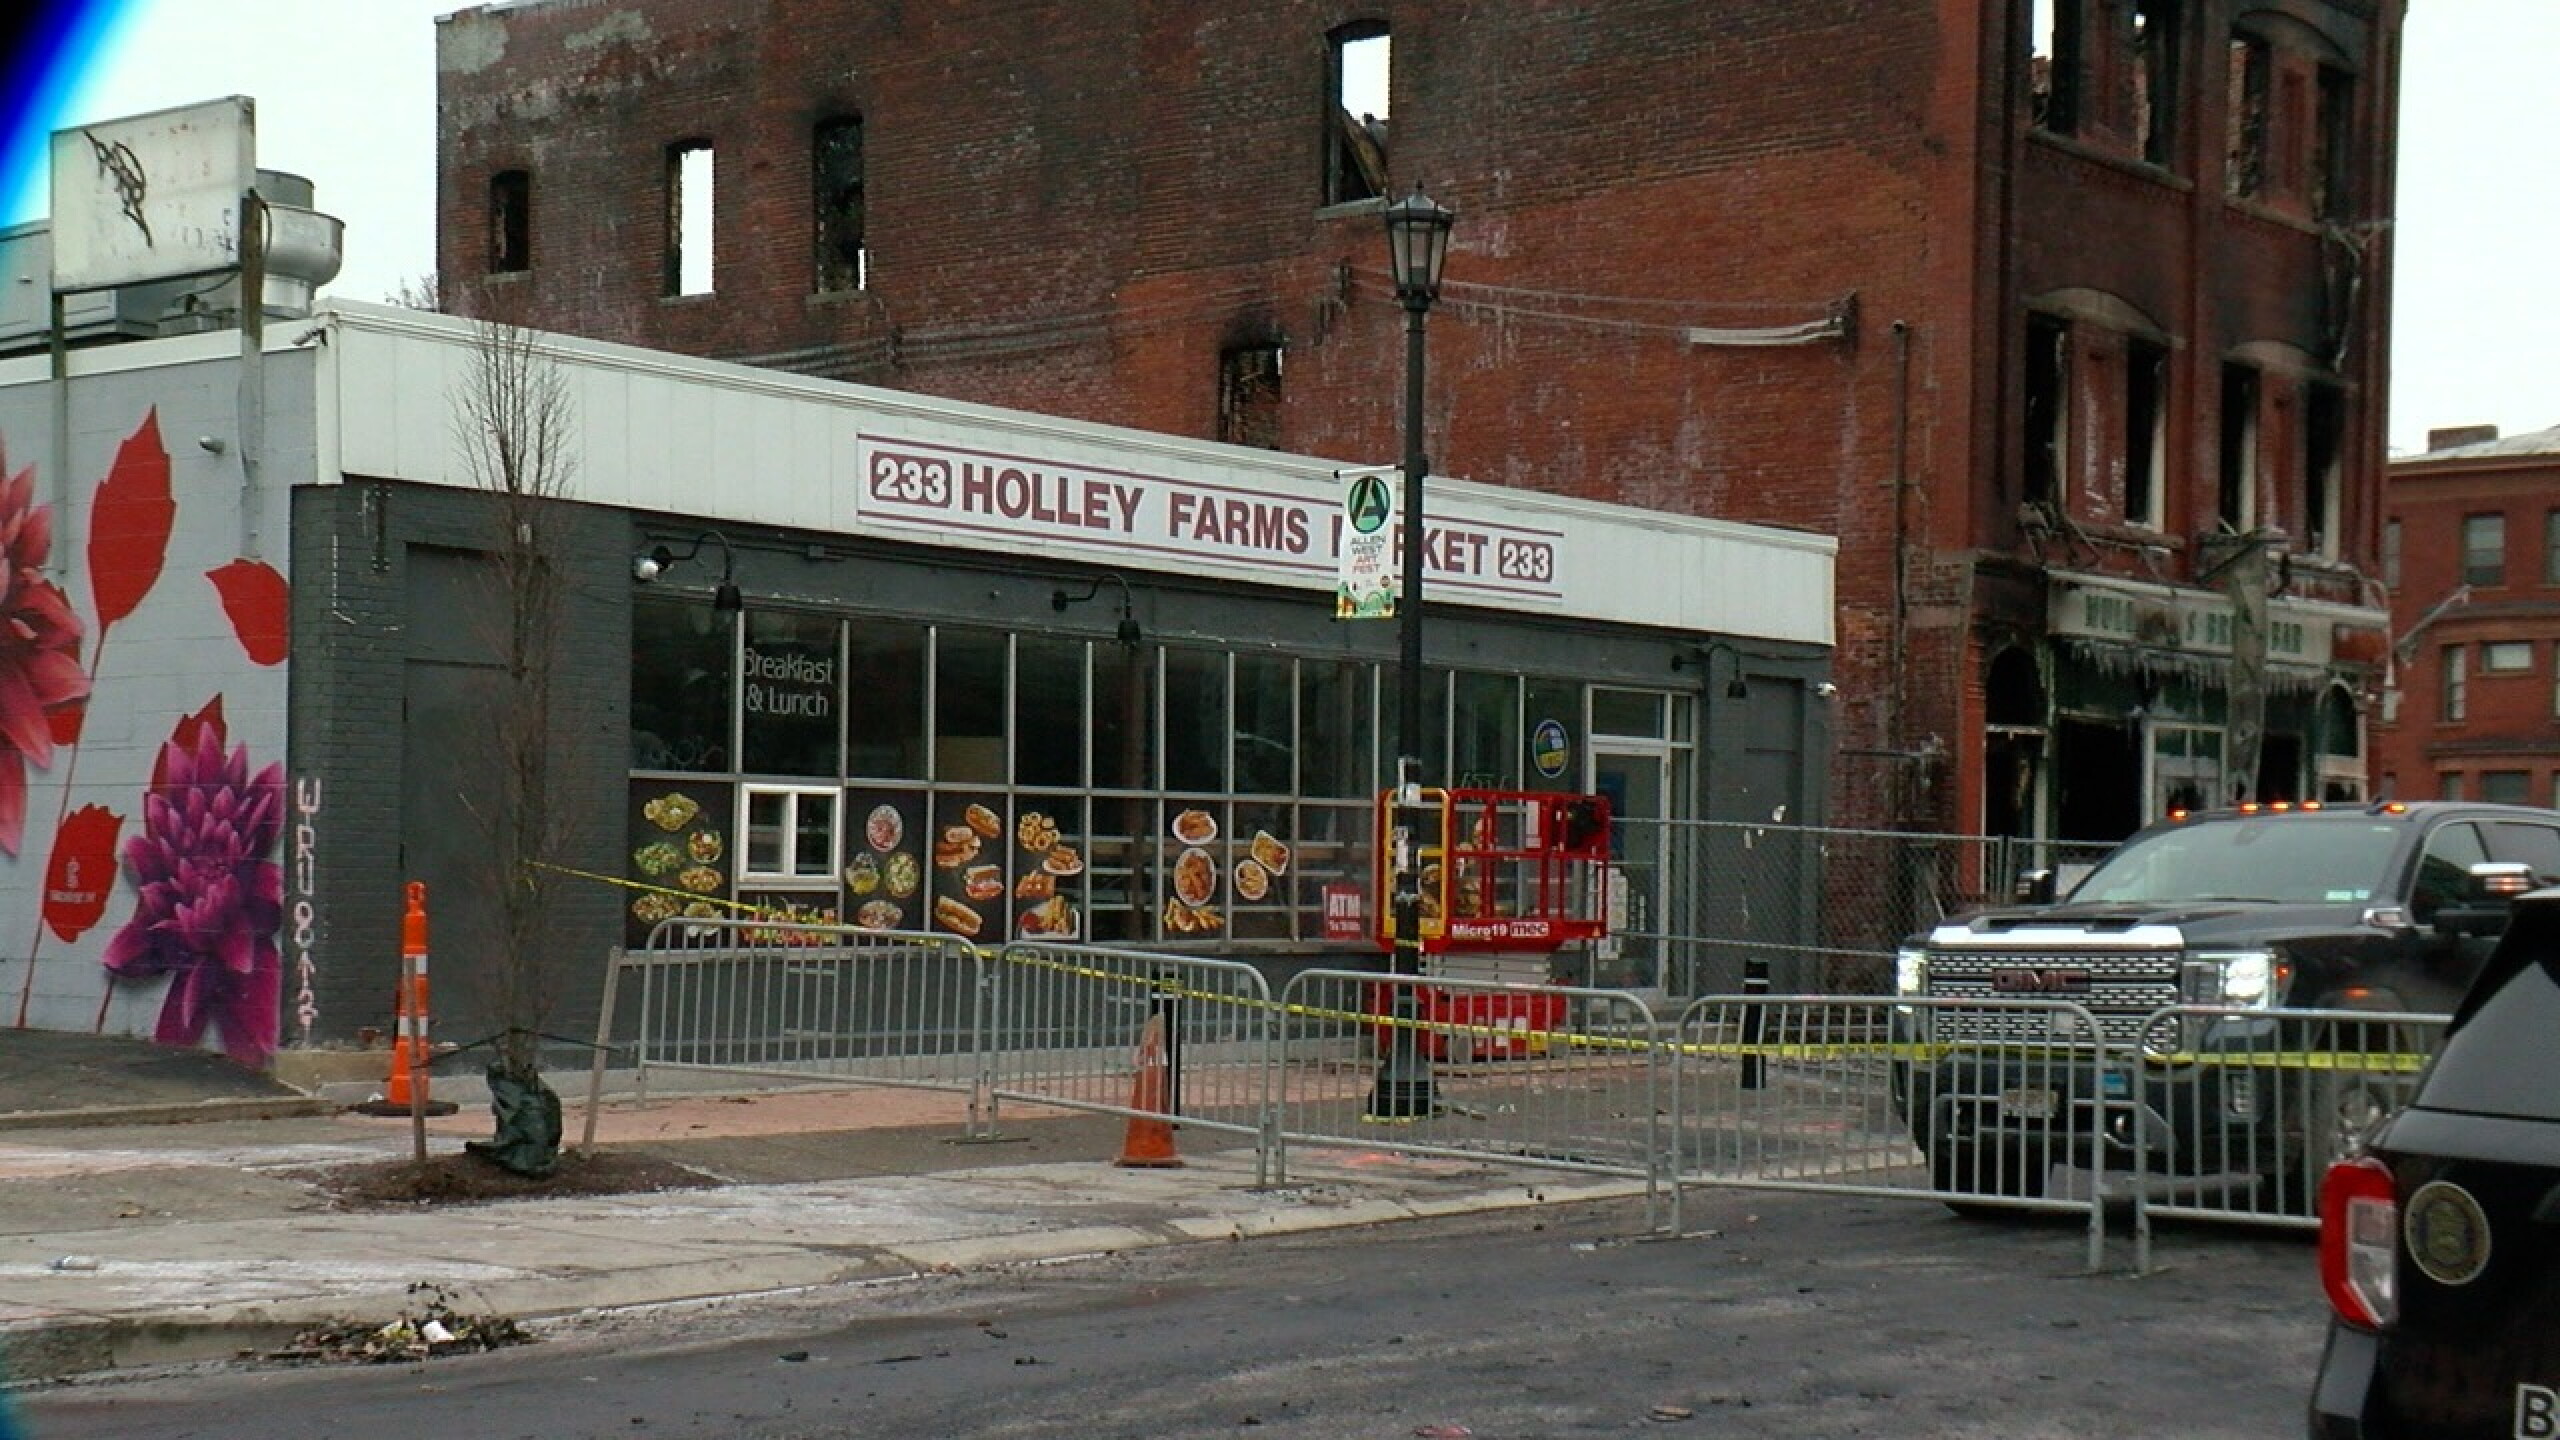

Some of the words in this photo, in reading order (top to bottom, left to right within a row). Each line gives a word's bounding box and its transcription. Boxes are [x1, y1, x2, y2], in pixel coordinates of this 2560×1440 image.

[876, 457, 947, 503] 233
[962, 462, 1145, 532] HOLLEY
[1169, 491, 1309, 554] FARMS
[1332, 514, 1489, 577] RKET
[1502, 542, 1550, 579] 233
[1350, 536, 1386, 546] ALLEN
[1351, 544, 1383, 555] WEST
[1352, 564, 1381, 574] FEST
[1355, 554, 1379, 564] ART
[744, 648, 833, 685] Breakfast
[745, 684, 763, 711] &
[769, 685, 829, 717] Lunch
[1329, 893, 1361, 918] ATM
[1993, 969, 2090, 992] GMC
